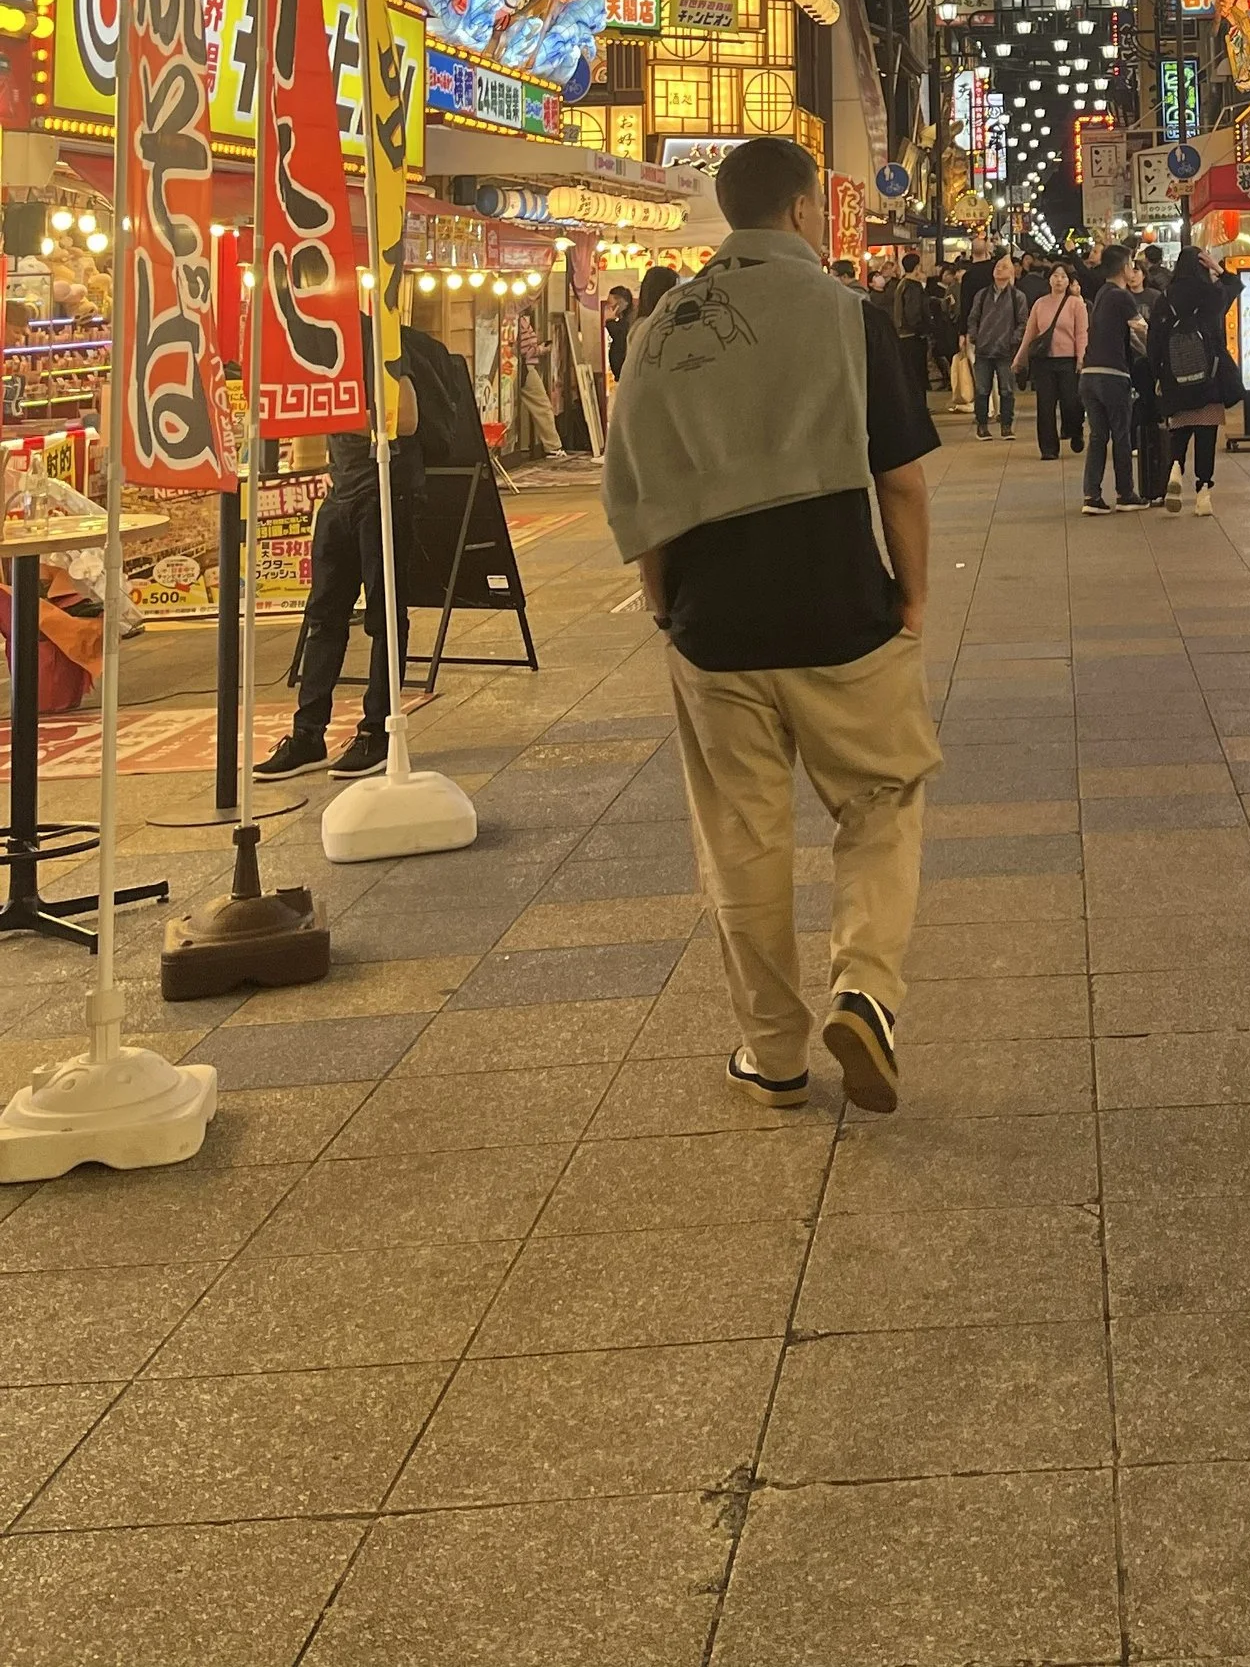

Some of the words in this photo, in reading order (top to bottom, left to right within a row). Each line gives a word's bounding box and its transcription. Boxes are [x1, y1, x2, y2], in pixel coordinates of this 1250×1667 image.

[678, 10, 734, 28] チャンピオン
[46, 446, 72, 479] 射的
[255, 559, 293, 570] クター
